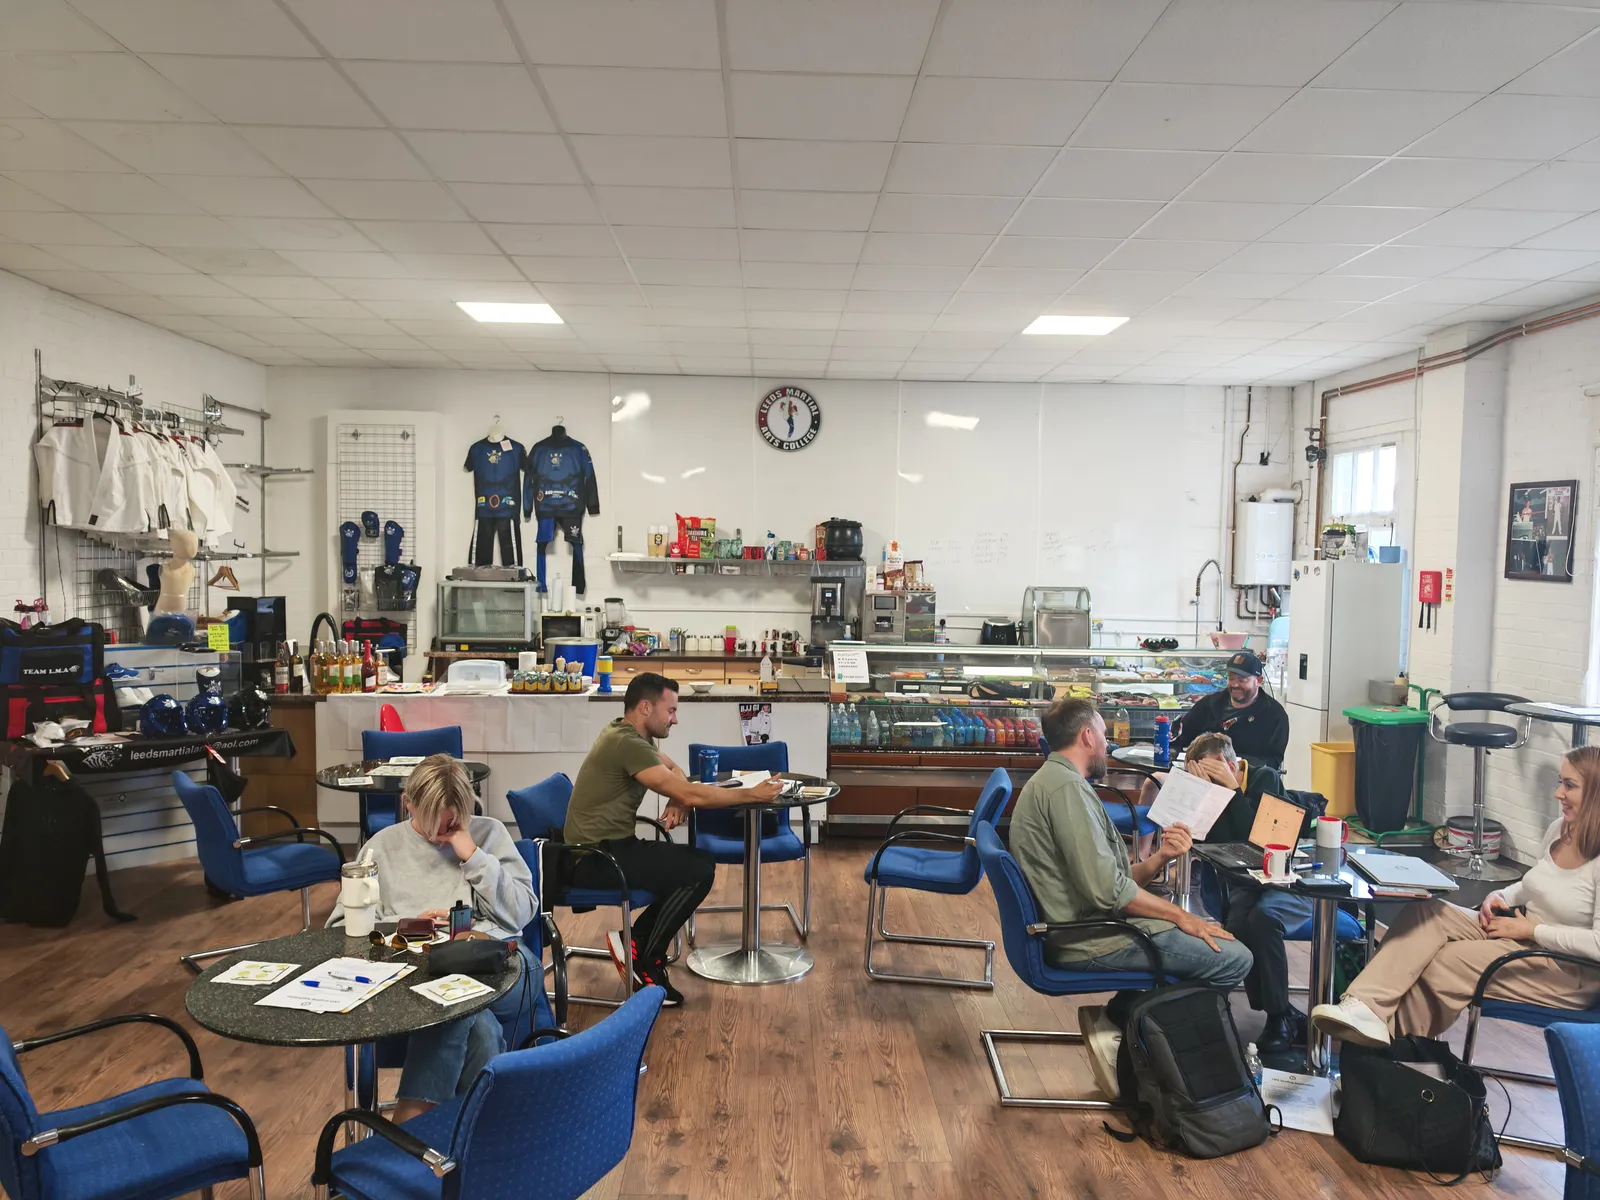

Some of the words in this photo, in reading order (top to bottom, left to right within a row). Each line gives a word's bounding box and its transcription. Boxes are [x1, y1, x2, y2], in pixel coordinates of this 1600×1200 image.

[760, 390, 782, 413] LEEDS
[786, 388, 819, 416] MARTIAL
[761, 426, 780, 447] ARTS
[783, 428, 817, 450] COLLEGE
[130, 738, 259, 760] leedsmartialar@aol.com
